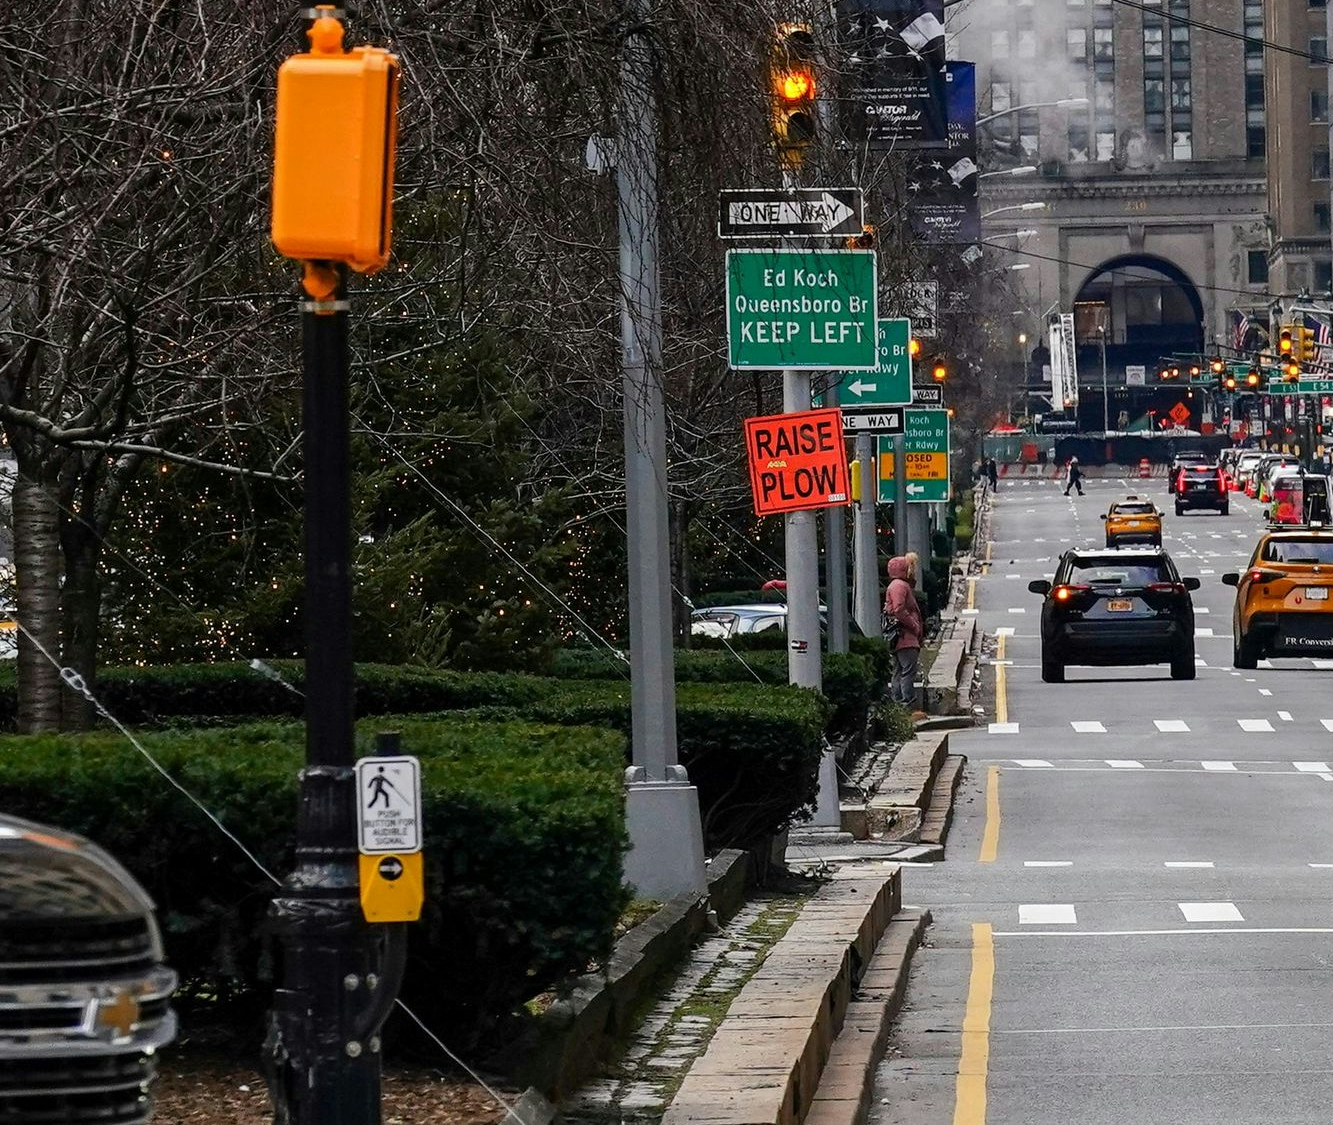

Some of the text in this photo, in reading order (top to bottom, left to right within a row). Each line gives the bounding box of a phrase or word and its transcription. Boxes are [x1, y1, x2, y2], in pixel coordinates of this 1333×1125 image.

[740, 204, 840, 222] ONE WAY
[764, 269, 839, 287] Ed Koch
[735, 295, 868, 314] Queensboro Br
[741, 322, 800, 344] KEEP
[811, 322, 865, 344] LEFT
[893, 345, 905, 356] Br
[1320, 382, 1329, 391] 54
[917, 391, 936, 400] WAY
[868, 416, 893, 427] WAY
[910, 416, 930, 425] Koch
[936, 429, 944, 437] Br
[755, 421, 834, 460] RAISE
[916, 441, 939, 451] Rdwy
[761, 464, 837, 503] PLOW
[1285, 637, 1297, 645] FR
